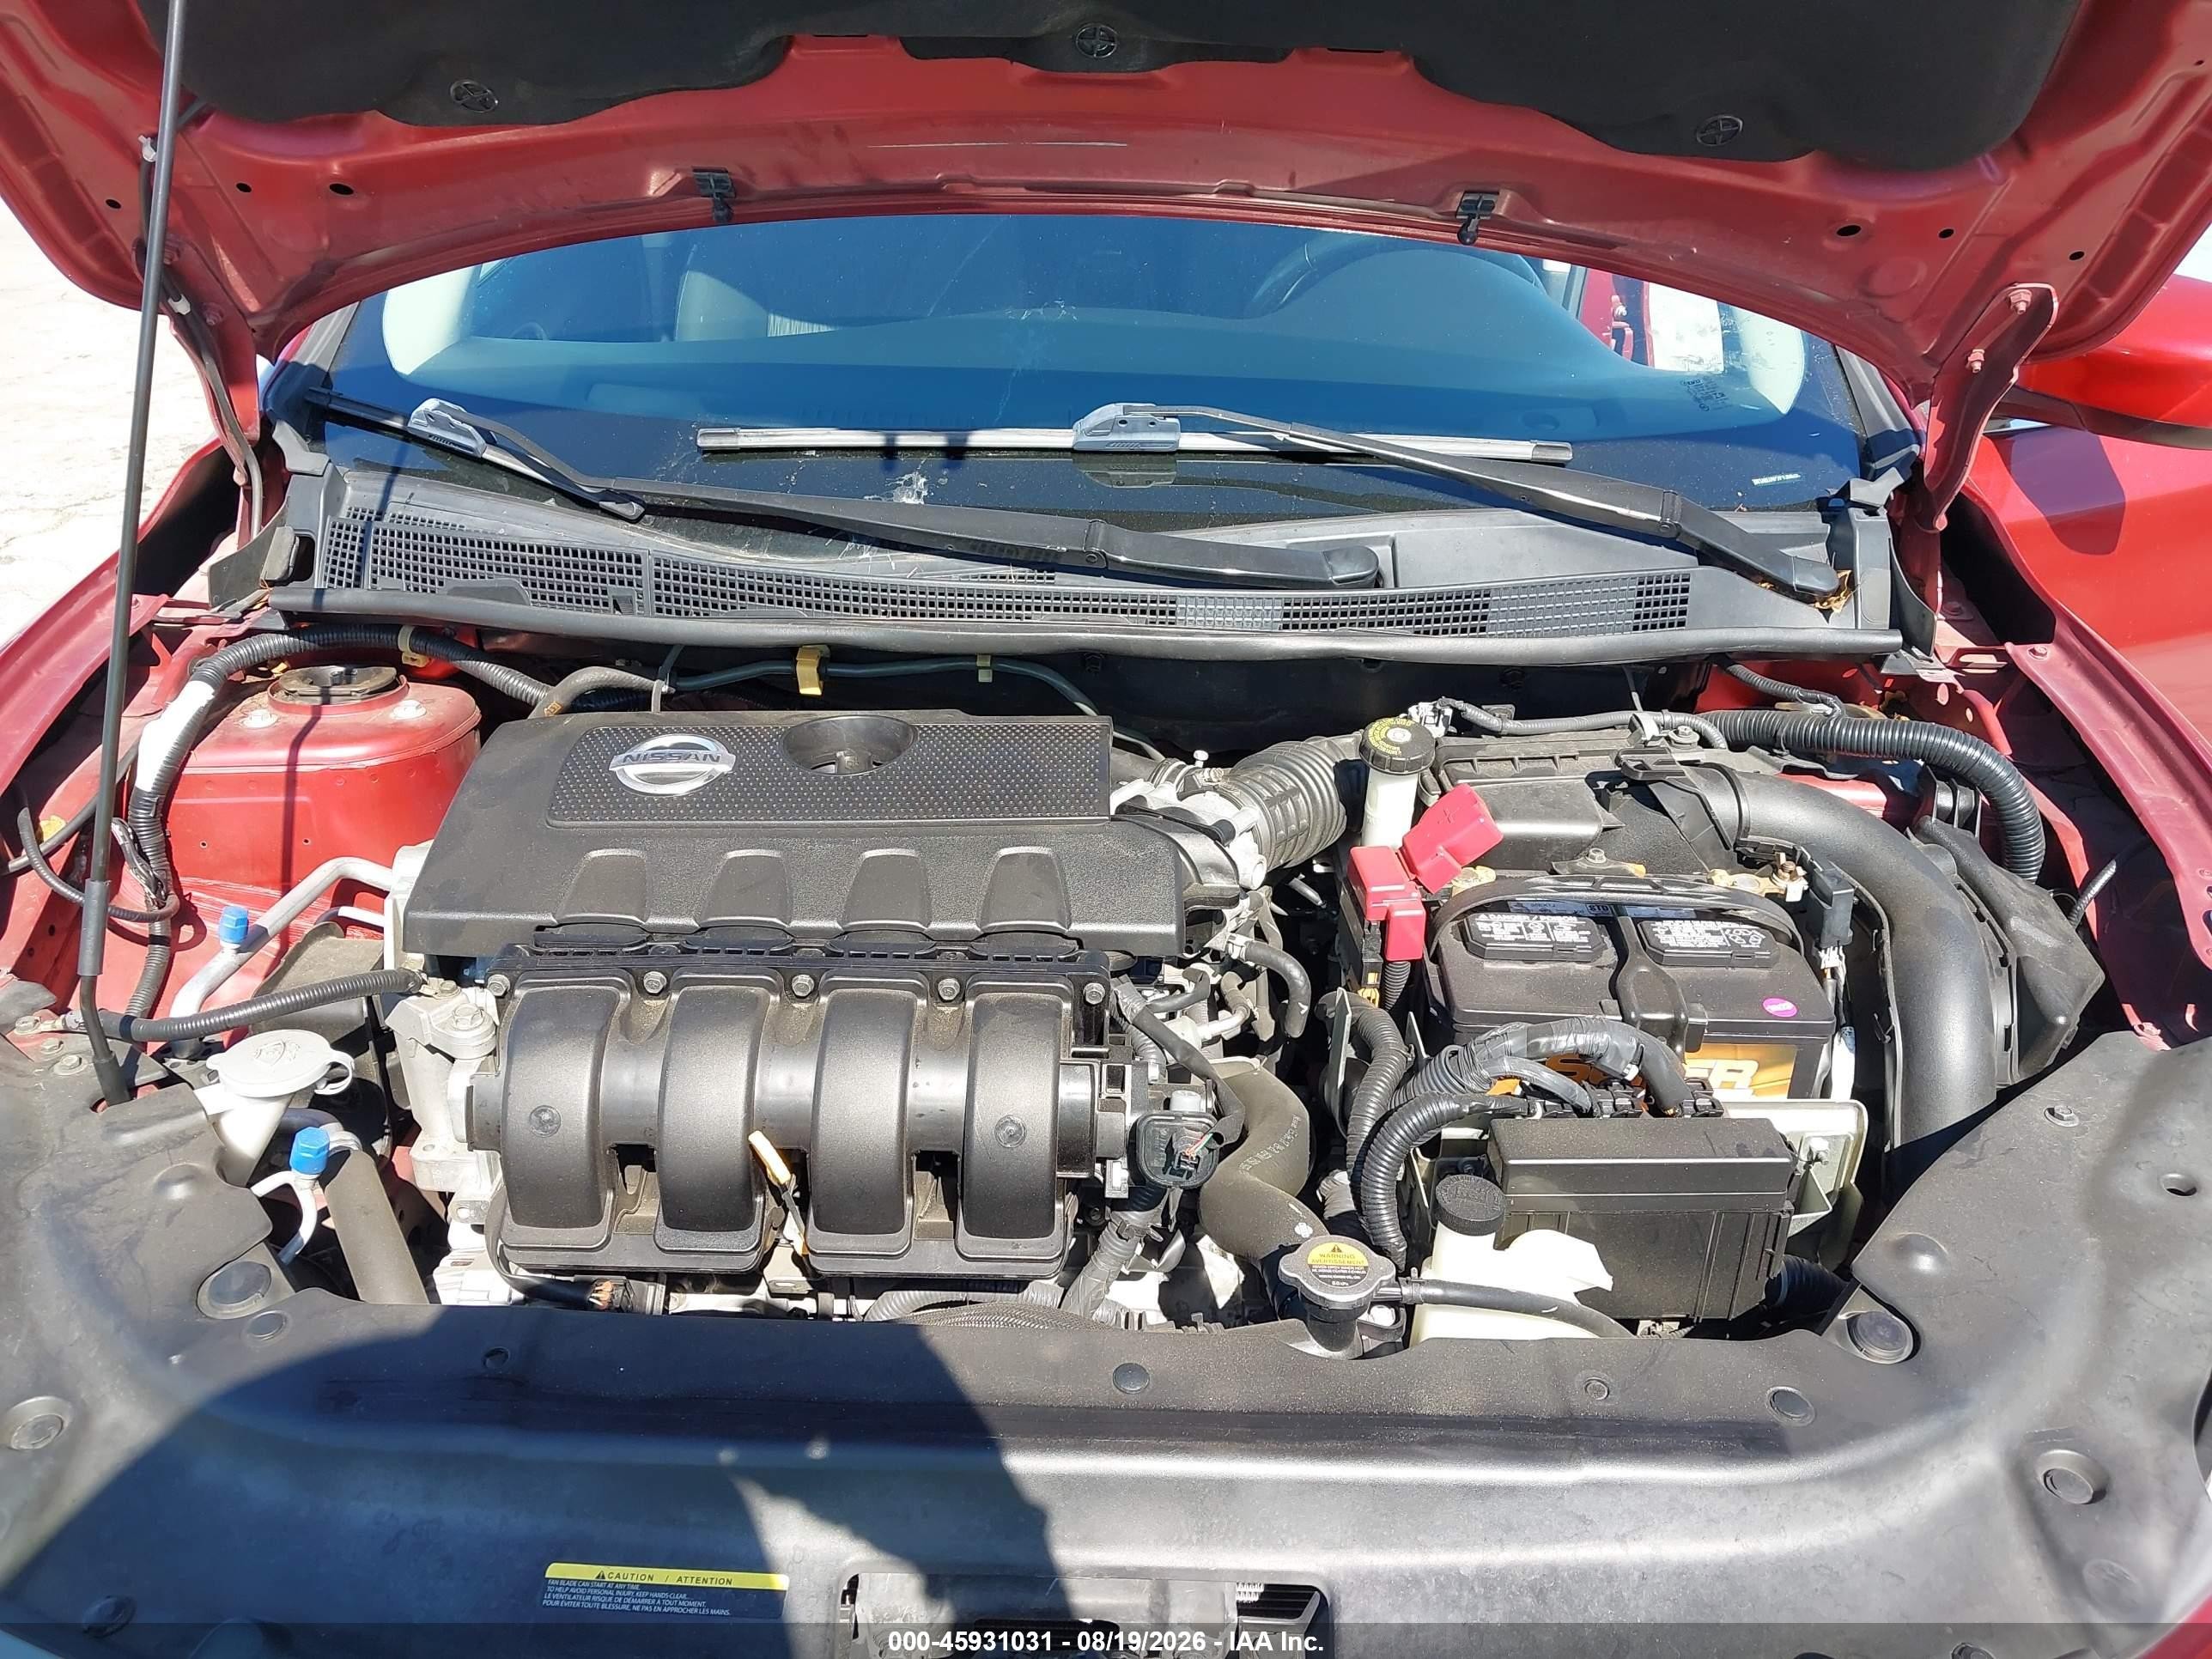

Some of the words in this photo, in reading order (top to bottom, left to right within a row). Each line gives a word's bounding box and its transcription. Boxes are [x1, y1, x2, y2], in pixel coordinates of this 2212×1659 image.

[622, 751, 722, 763] NISSAN
[1589, 904, 1609, 913] STD
[1486, 913, 1530, 921] DANGER
[607, 1571, 654, 1582] CAUTION
[676, 1576, 733, 1585] ATTENTION
[552, 1593, 592, 1601] VENTILATEUR
